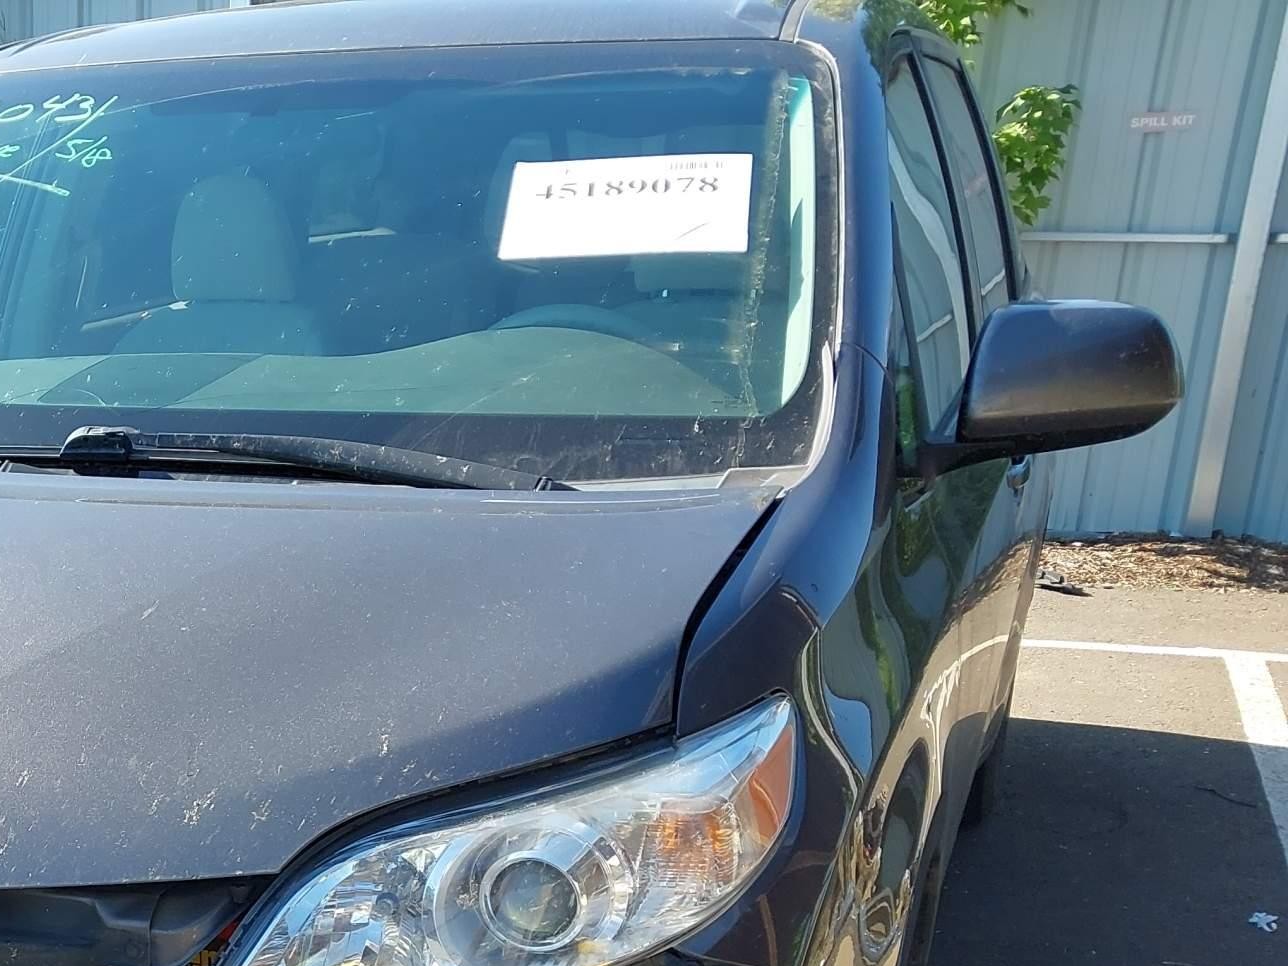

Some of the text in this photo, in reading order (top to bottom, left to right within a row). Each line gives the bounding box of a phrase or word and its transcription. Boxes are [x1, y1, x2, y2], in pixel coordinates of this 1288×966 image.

[1130, 114, 1196, 129] SPILL KIT
[535, 175, 721, 200] 45189078
